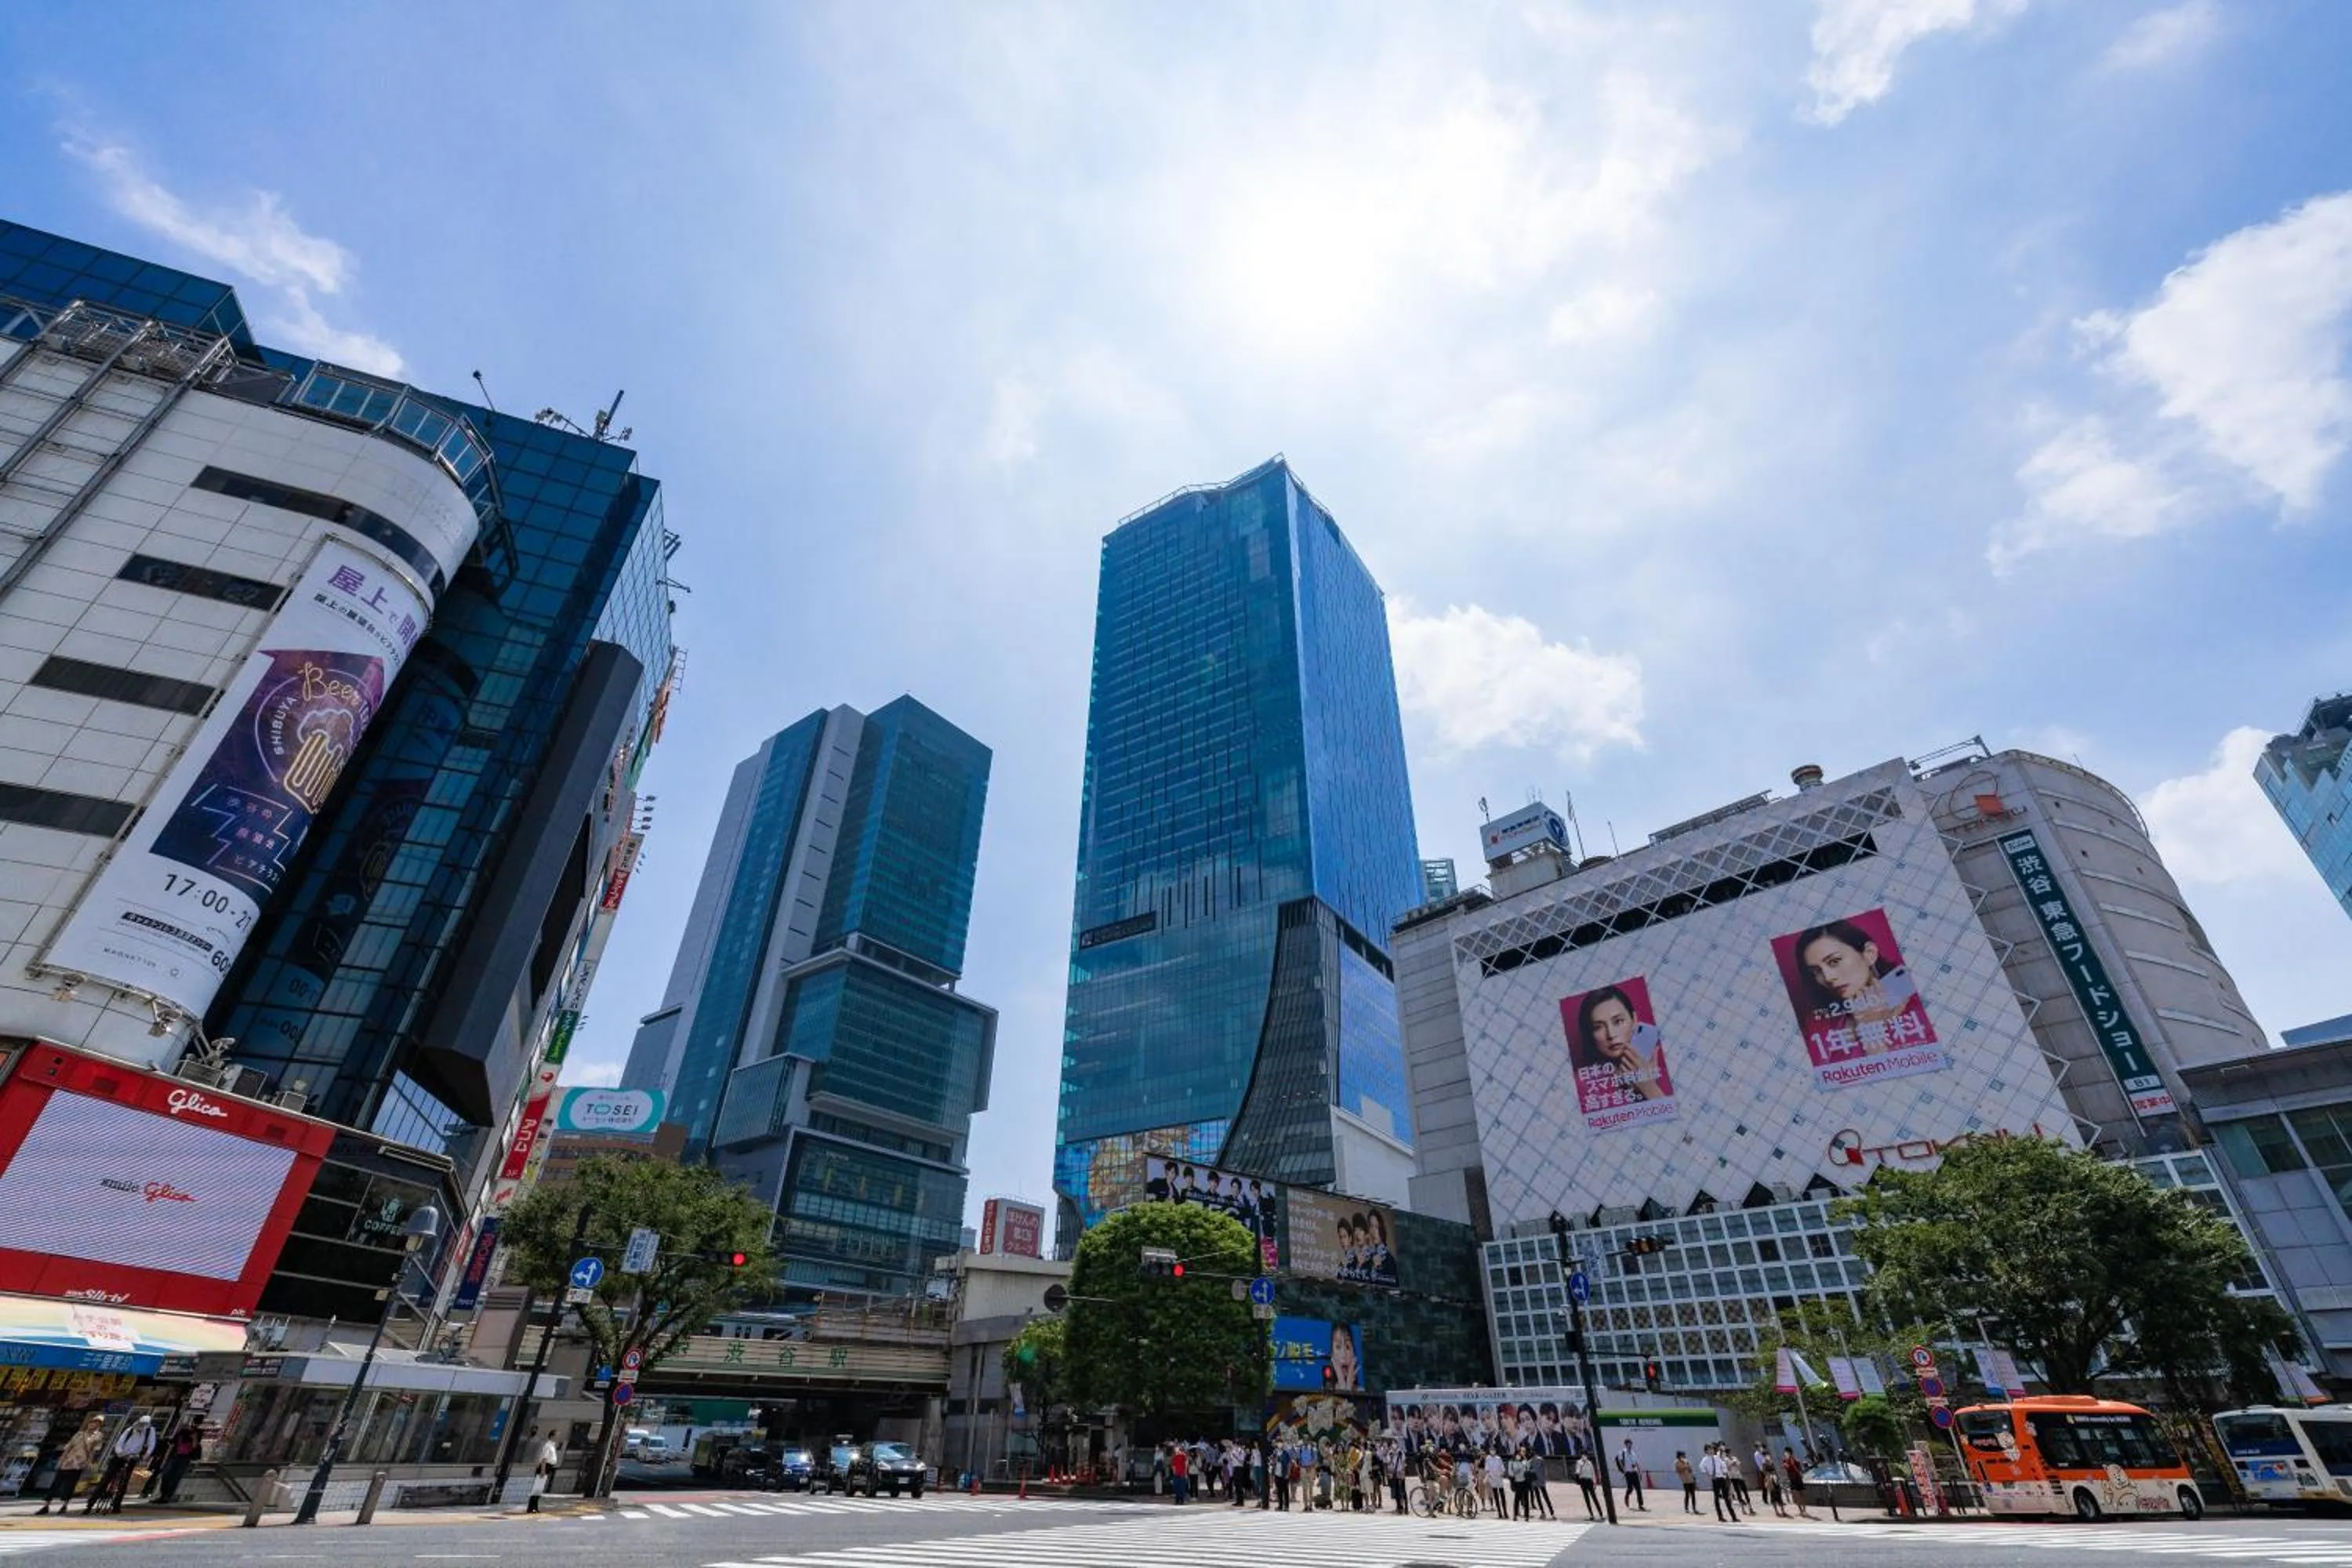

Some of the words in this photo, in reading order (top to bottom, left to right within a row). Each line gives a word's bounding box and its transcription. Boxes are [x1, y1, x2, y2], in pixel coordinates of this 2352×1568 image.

[270, 696, 297, 755] SHIBUYA
[2017, 855, 2052, 895] 渋谷
[2039, 900, 2139, 1072] 東急フードショー
[1810, 1010, 1926, 1060] 1年無料
[1577, 1061, 1615, 1080] 日本の
[1821, 1062, 1888, 1083] Rakuten
[1887, 1051, 1939, 1070] Mobile
[168, 1089, 228, 1117] Glico
[1588, 1109, 1635, 1129] Rakuten
[1635, 1102, 1674, 1117] Mobile
[144, 1181, 201, 1204] Glico
[724, 1339, 849, 1369] 渋谷駅
